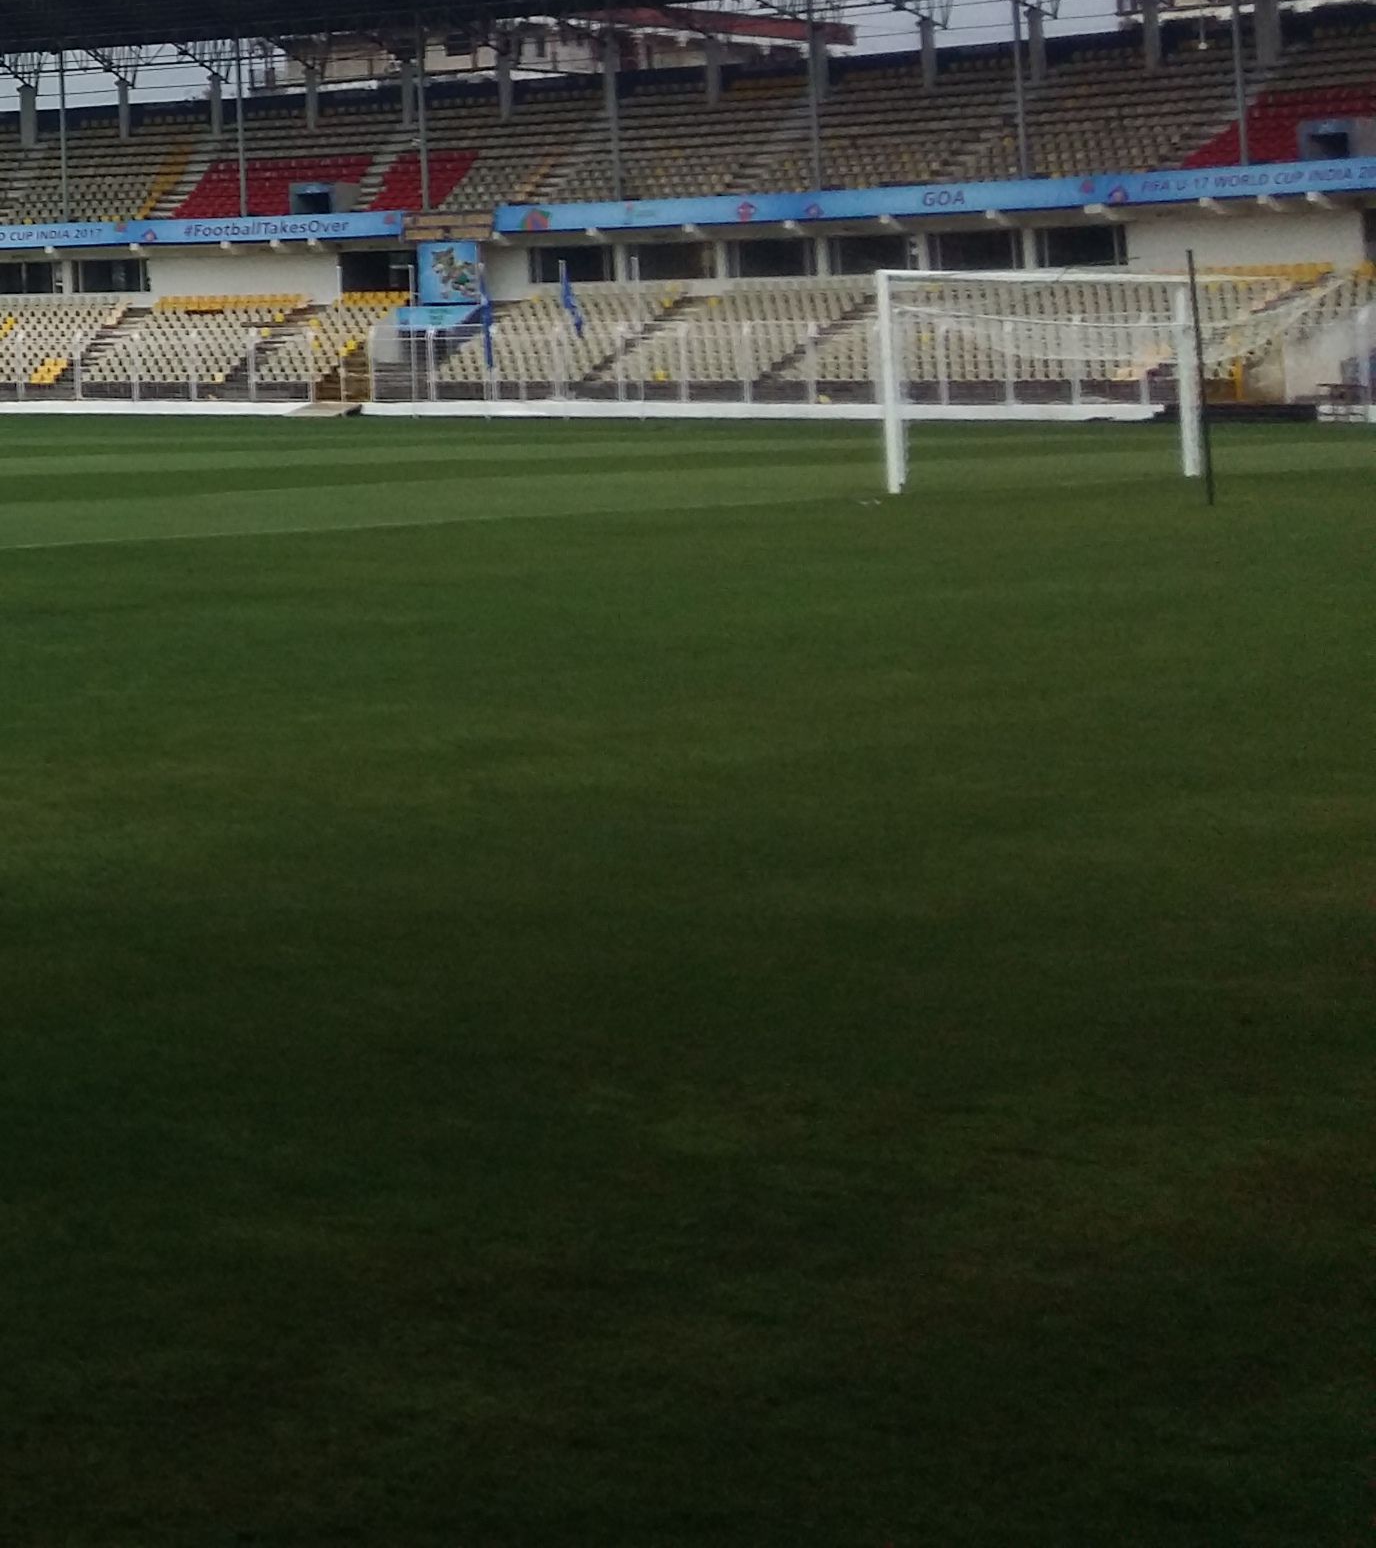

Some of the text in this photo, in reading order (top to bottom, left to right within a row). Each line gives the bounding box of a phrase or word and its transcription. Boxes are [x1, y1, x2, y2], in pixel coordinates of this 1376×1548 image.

[1214, 174, 1269, 189] WORLD
[1273, 170, 1305, 185] CUP
[922, 190, 966, 206] GOA
[10, 231, 33, 241] CUP
[36, 230, 70, 240] INDIA
[74, 228, 103, 239] 2017
[184, 220, 350, 237] #FootballTakesOver
